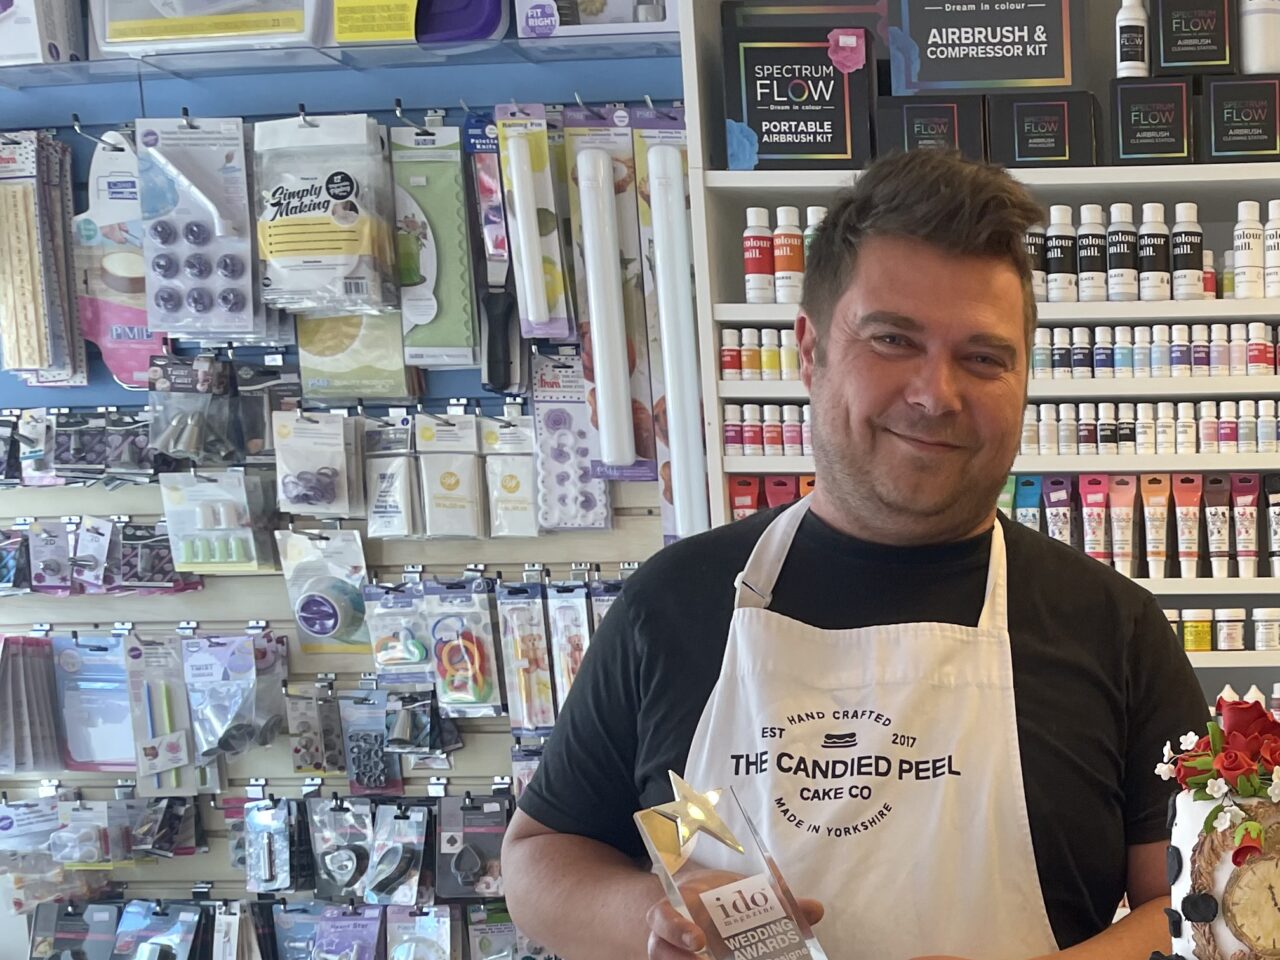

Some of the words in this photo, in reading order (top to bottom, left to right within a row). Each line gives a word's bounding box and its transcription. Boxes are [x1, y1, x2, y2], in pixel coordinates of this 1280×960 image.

[528, 8, 543, 18] FIT
[945, 3, 976, 12] Dream
[980, 3, 989, 11] in
[995, 2, 1026, 11] colour
[528, 17, 557, 27] RIGHT
[1172, 18, 1217, 32] FLOW
[927, 26, 1029, 44] AIRBRUSH
[1033, 25, 1048, 42] &
[926, 45, 1023, 59] COMPRESSOR
[1026, 44, 1048, 56] KIT
[754, 65, 834, 78] SPECTRUM
[756, 79, 835, 102] FLOW
[1131, 111, 1175, 124] FLOW
[1223, 108, 1268, 122] FLOW
[761, 121, 833, 133] PORTABLE
[914, 123, 949, 135] FLOW
[1024, 122, 1059, 134] FLOW
[1228, 128, 1262, 136] AIRBRUSH
[762, 133, 814, 143] AIRBRUSH
[816, 133, 833, 143] KIT
[271, 184, 323, 202] Simply
[270, 199, 331, 222] Making
[1047, 237, 1073, 247] olour
[1140, 235, 1166, 245] olour
[787, 711, 825, 726] HAND
[832, 709, 892, 727] CRAFTED
[761, 727, 786, 739] EST
[891, 733, 917, 748] 2017
[730, 750, 769, 776] THE
[776, 752, 892, 780] CANDIED
[898, 755, 962, 780] PEEL
[799, 787, 844, 802] CAKE
[848, 785, 872, 800] CO
[774, 797, 805, 829] MADE
[807, 823, 821, 834] IN
[826, 802, 893, 838] YORKSHIRE
[723, 906, 776, 927] magazine
[724, 919, 794, 951] WEDDING
